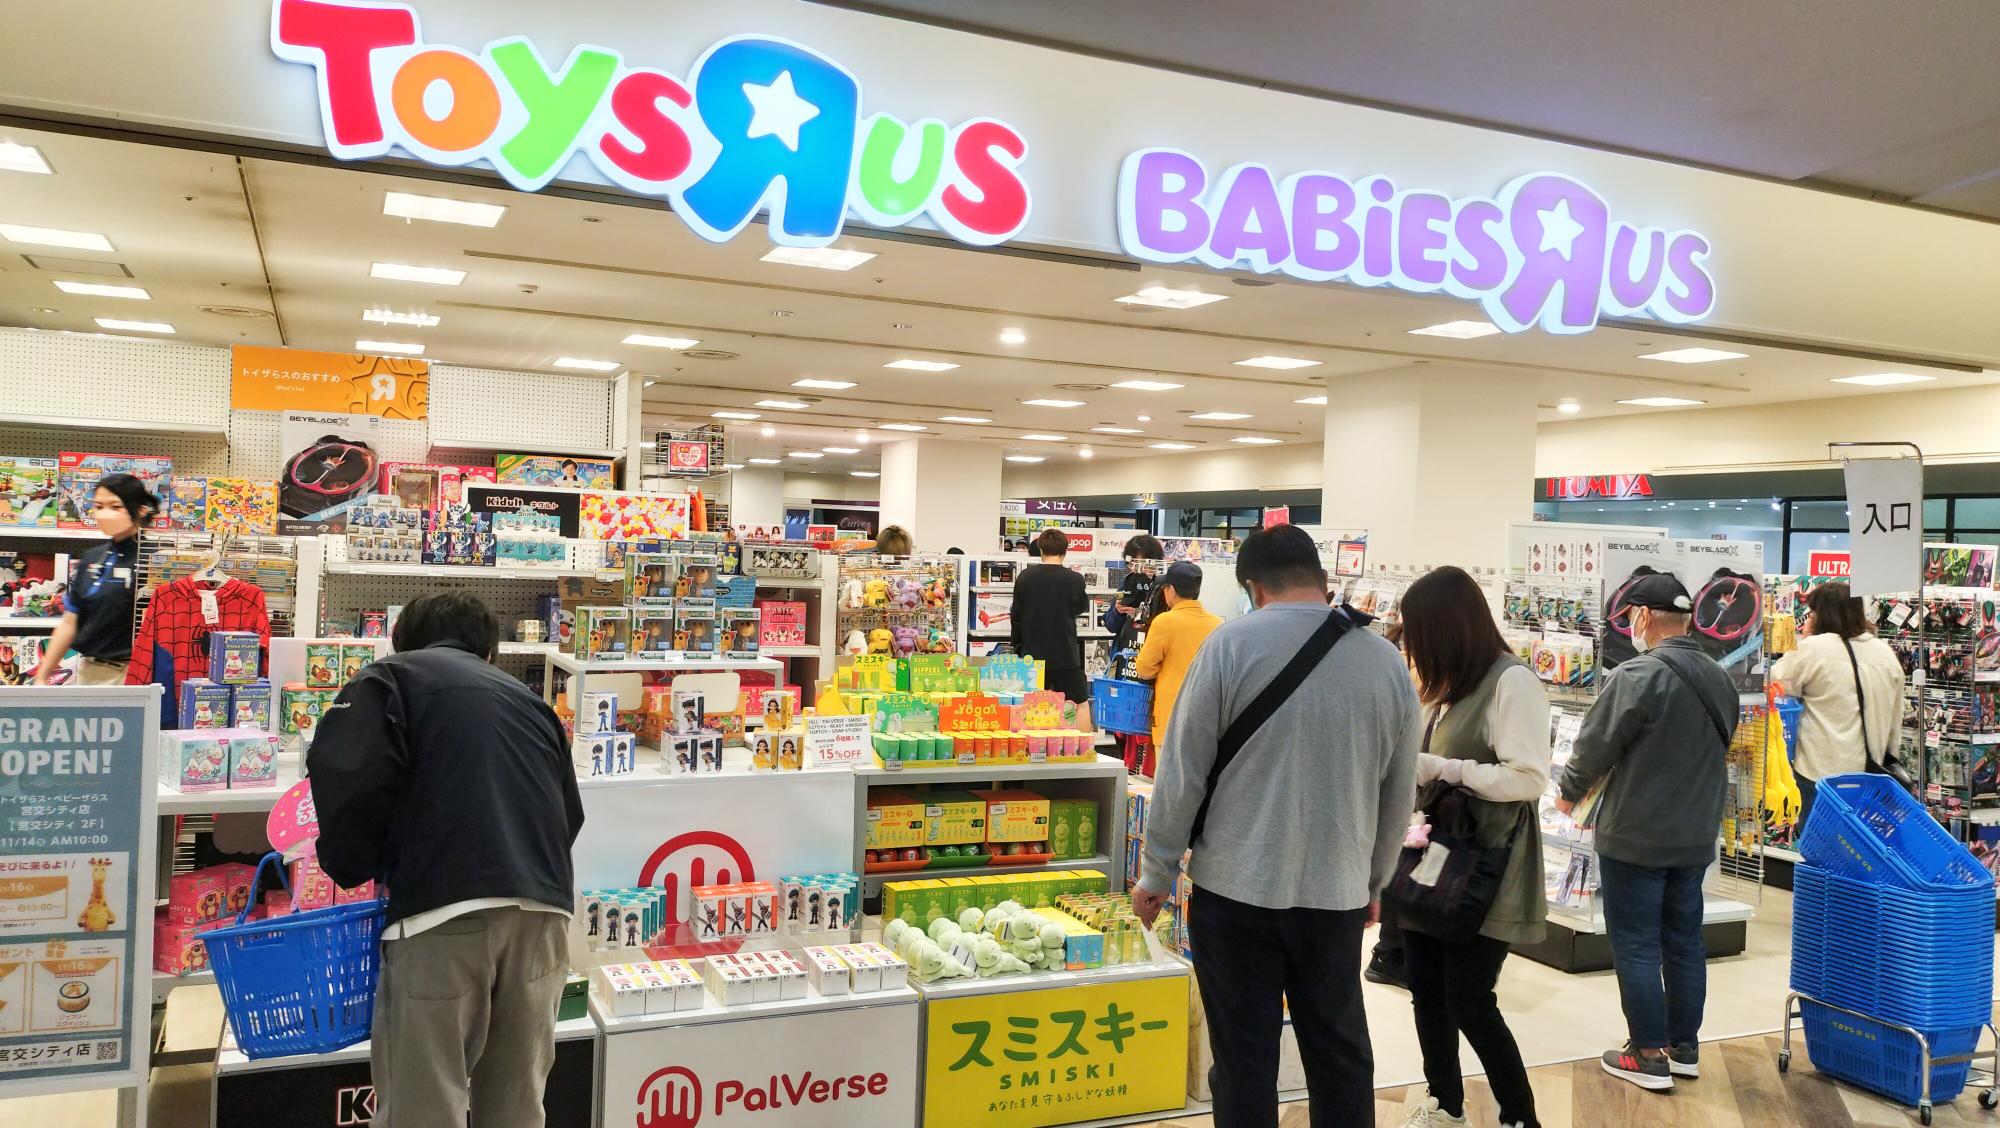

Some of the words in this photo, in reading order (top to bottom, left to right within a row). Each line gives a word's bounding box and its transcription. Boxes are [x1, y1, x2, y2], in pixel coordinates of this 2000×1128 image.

[241, 367, 341, 383] トイザらスのおすすめ
[486, 496, 524, 507] Kidult
[1861, 502, 1912, 535] 入口
[856, 655, 890, 664] スミスキー
[0, 717, 124, 744] GRAND
[952, 719, 996, 730] Series
[1, 749, 113, 775] OPEN!
[20, 804, 91, 816] 宮交シティ店
[50, 834, 108, 846] AM10:00
[949, 1002, 1169, 1072] スミスキー
[0, 1042, 91, 1061] 宮交シティ店
[1000, 1062, 1115, 1090] SMISKI
[714, 1071, 889, 1116] PalVerse
